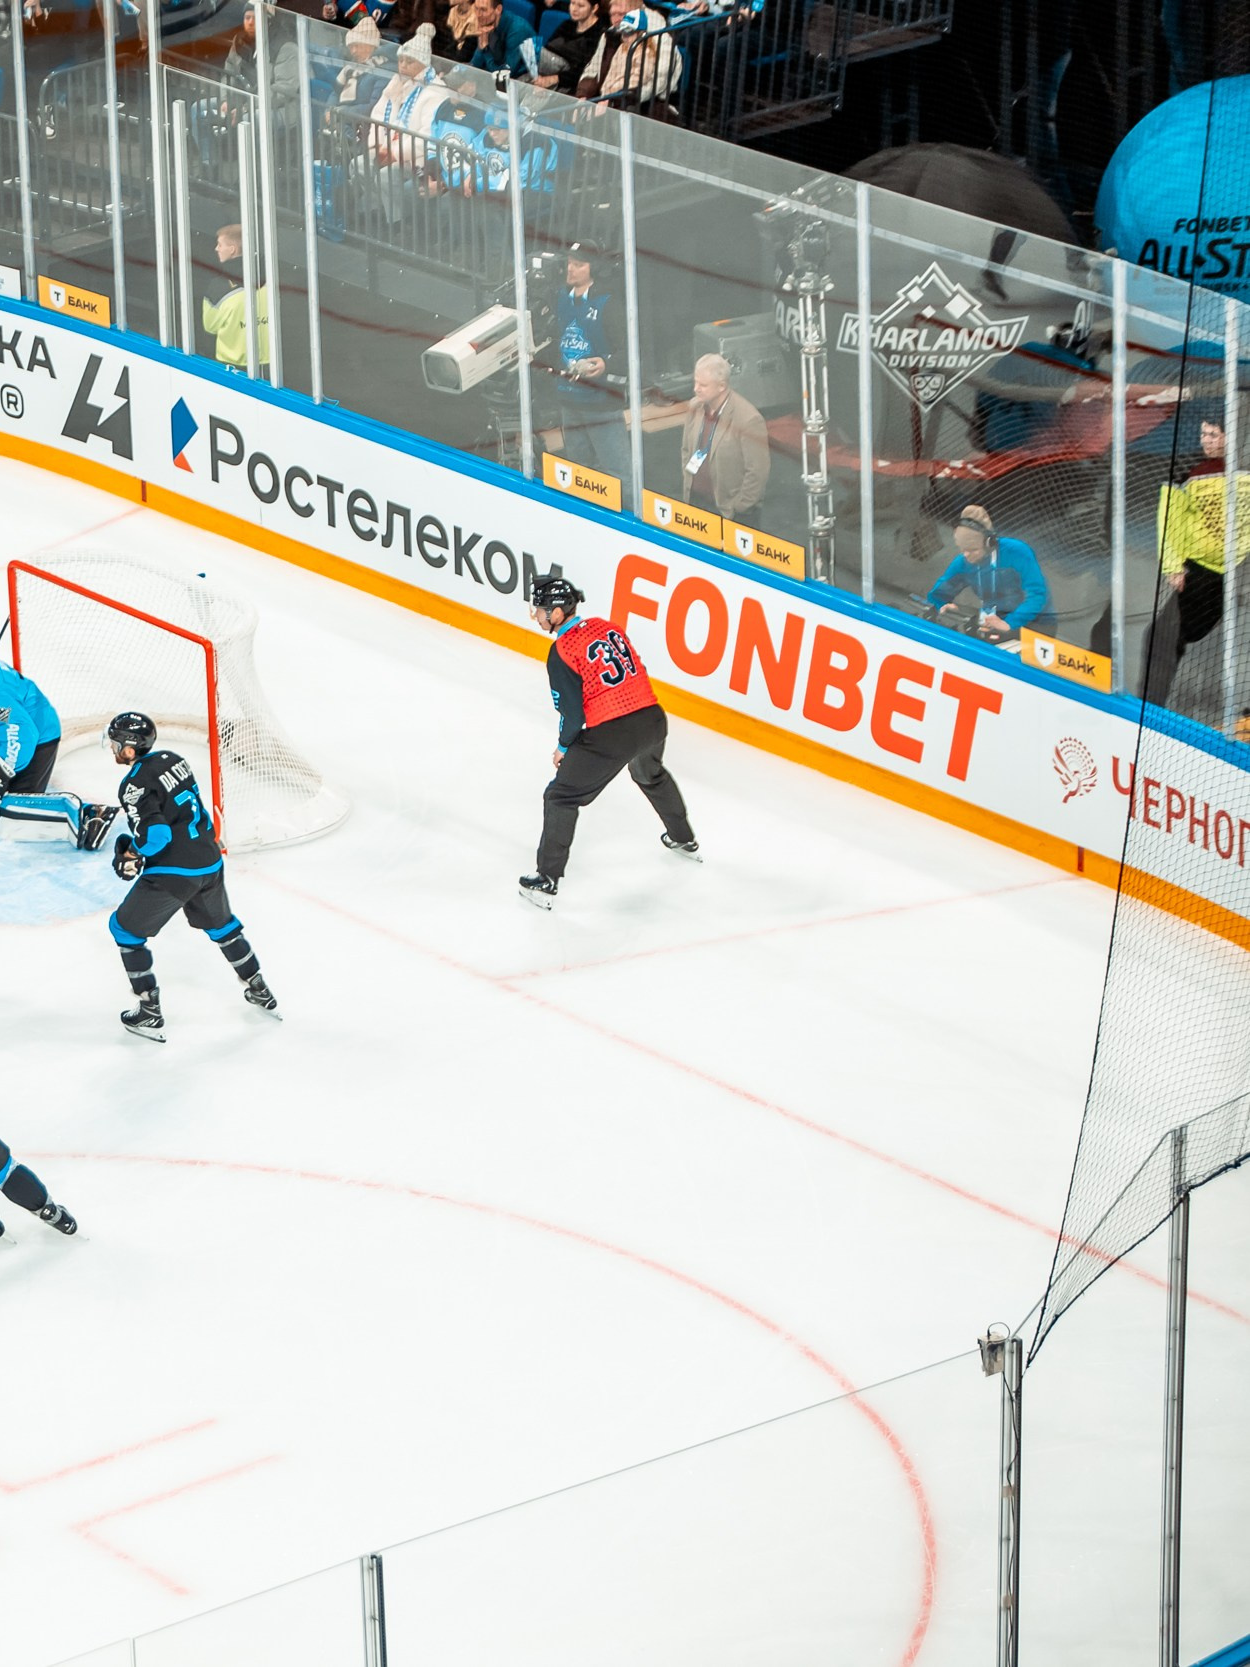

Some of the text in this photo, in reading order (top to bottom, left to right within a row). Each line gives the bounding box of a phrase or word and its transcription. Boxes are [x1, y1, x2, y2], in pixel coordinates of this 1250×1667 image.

[68, 295, 98, 315] БАНК
[888, 353, 971, 369] DIVISION
[575, 475, 608, 497] БАНК
[209, 414, 564, 602] Ростелеком
[674, 514, 708, 535] БАНК
[756, 543, 791, 566] БАНК
[586, 629, 638, 688] 39
[610, 553, 1003, 782] FONBET
[1058, 653, 1096, 677] БАНК
[158, 771, 179, 793] DA
